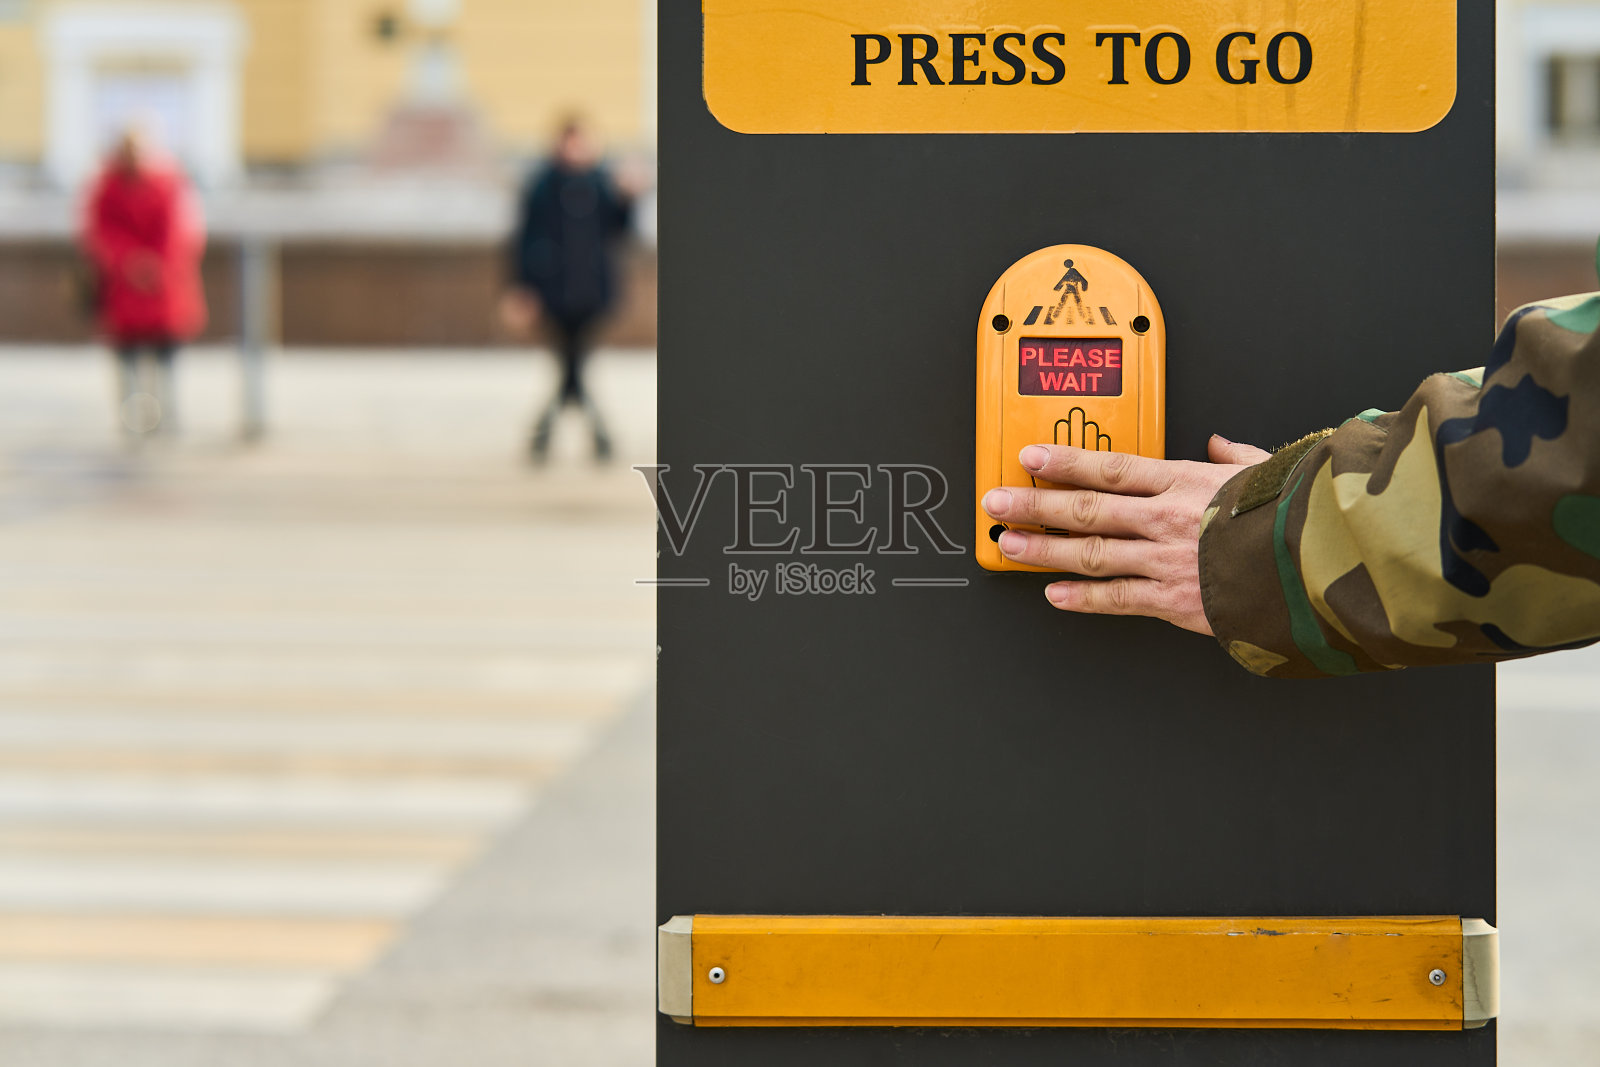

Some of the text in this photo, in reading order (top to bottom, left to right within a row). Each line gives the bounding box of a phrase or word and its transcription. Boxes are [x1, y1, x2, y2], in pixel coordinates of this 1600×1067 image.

[850, 31, 1314, 86] PRESS TO GO
[1021, 347, 1121, 368] PLEASE
[1039, 371, 1103, 392] WAIT
